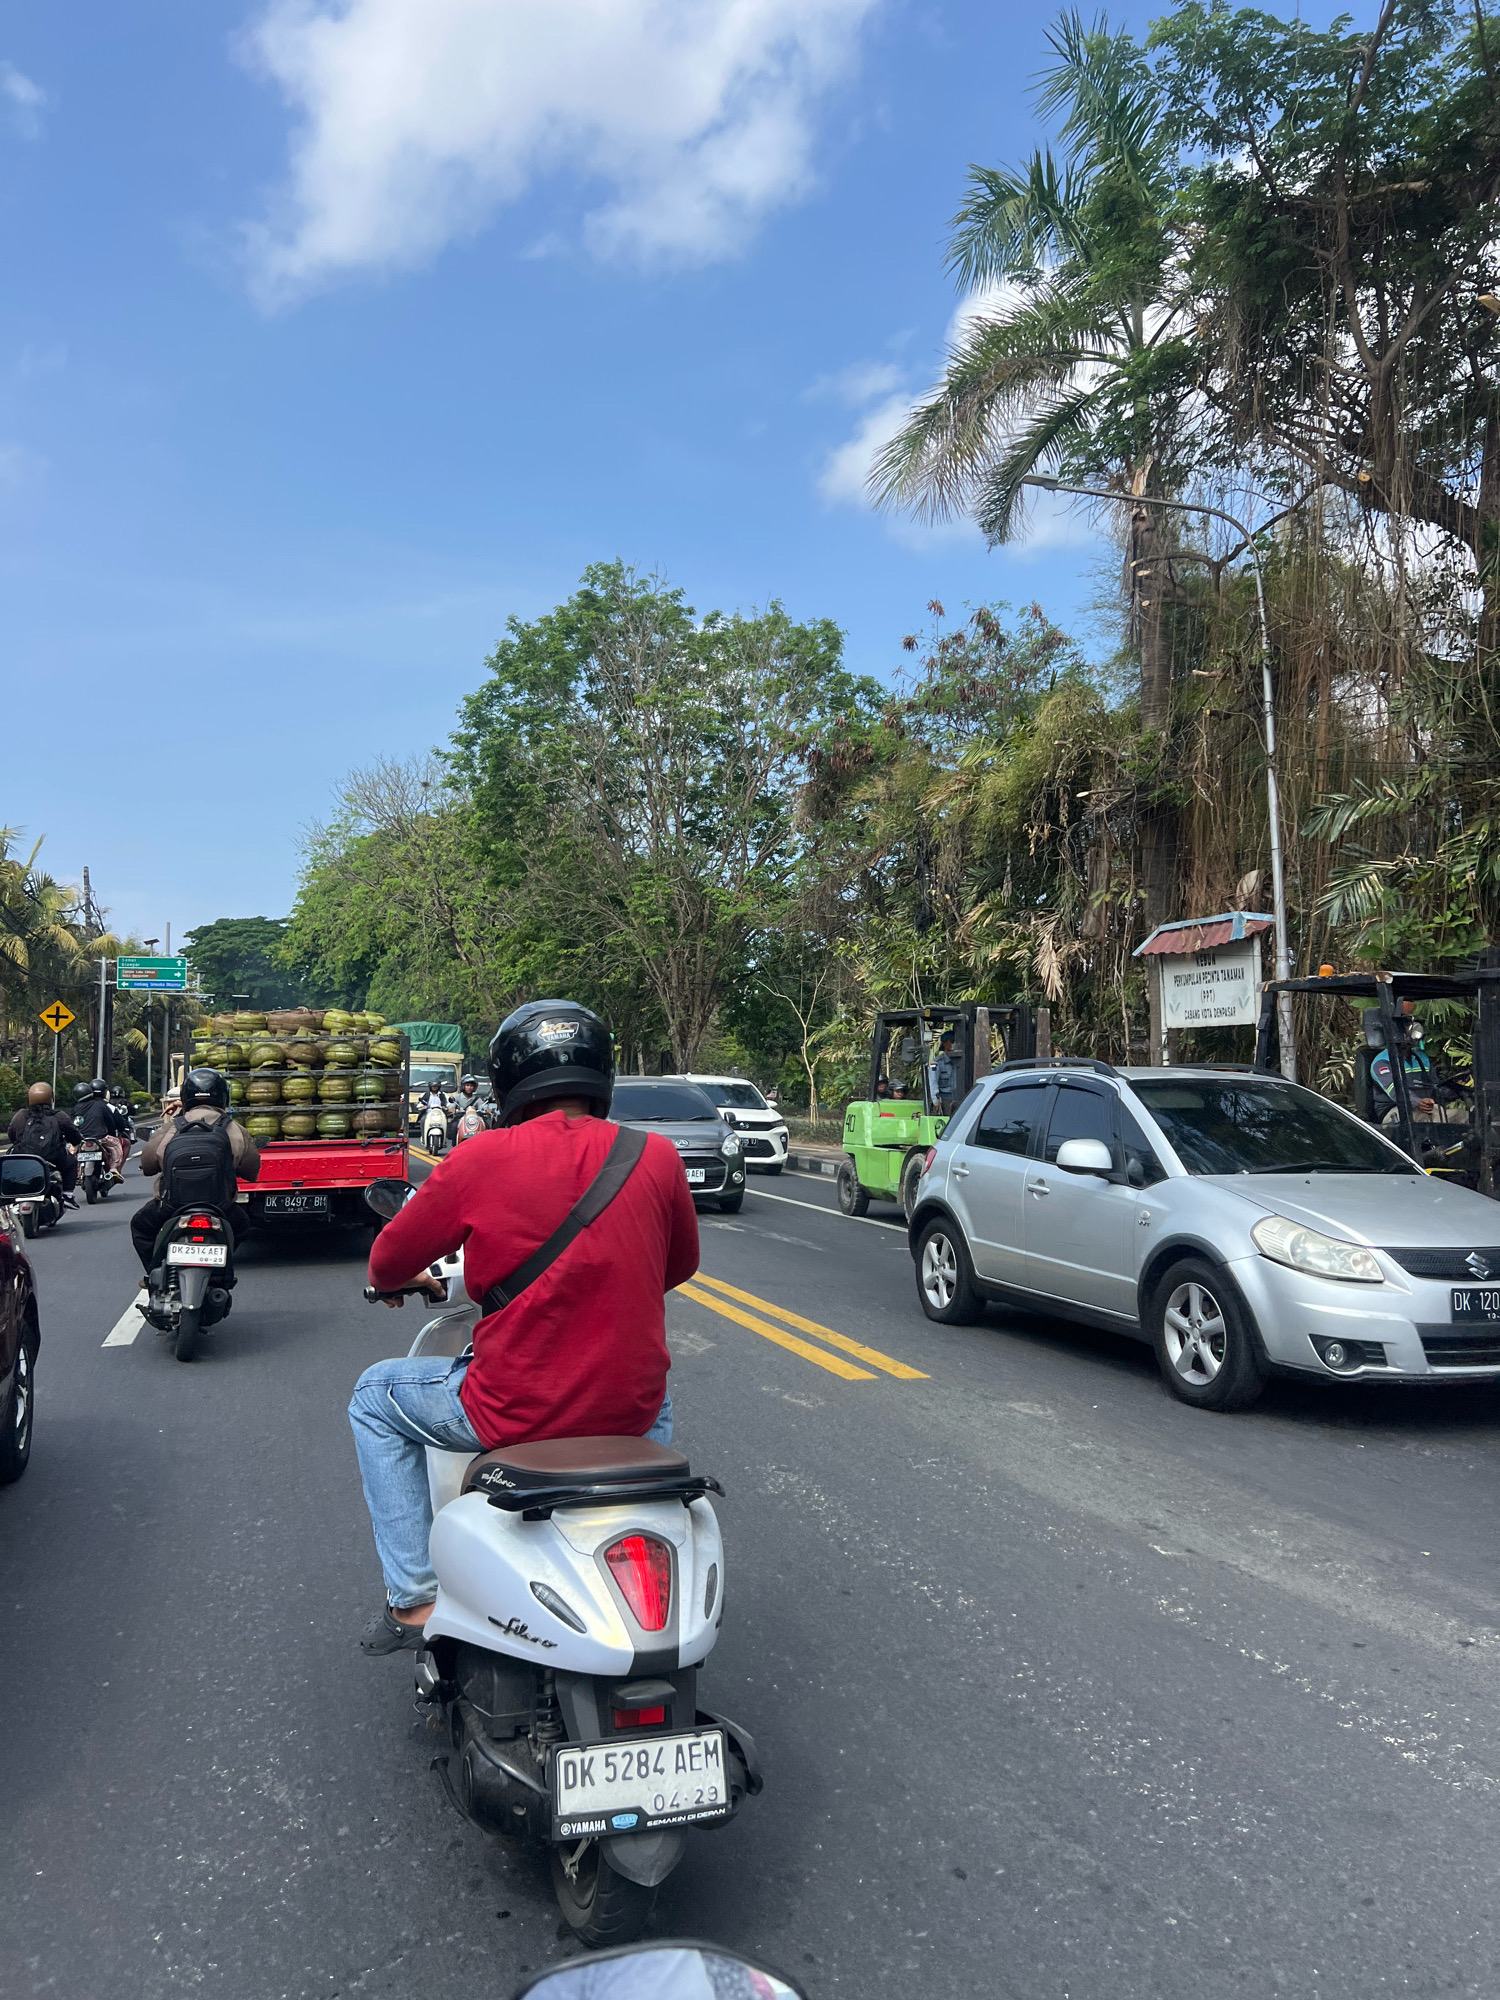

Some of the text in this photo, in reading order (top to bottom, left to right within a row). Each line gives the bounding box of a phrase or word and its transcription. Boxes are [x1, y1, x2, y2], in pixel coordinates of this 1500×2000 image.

[1196, 953, 1216, 967] KEBUN
[1202, 970, 1220, 984] PECINTA
[1221, 967, 1244, 981] TANAMAN
[1201, 988, 1215, 1003] (PPT)
[1184, 1006, 1236, 1020] CABANG KOTA DENPASAR
[266, 1197, 277, 1207] DK
[285, 1197, 307, 1207] 8497
[172, 1246, 183, 1254] DK
[1454, 1292, 1470, 1310] DK
[564, 1738, 719, 1789] DK 5284 AEM
[571, 1820, 606, 1834] YAMAHA
[647, 1816, 686, 1827] SEMAKIN
[697, 1808, 726, 1819] DEPAN
